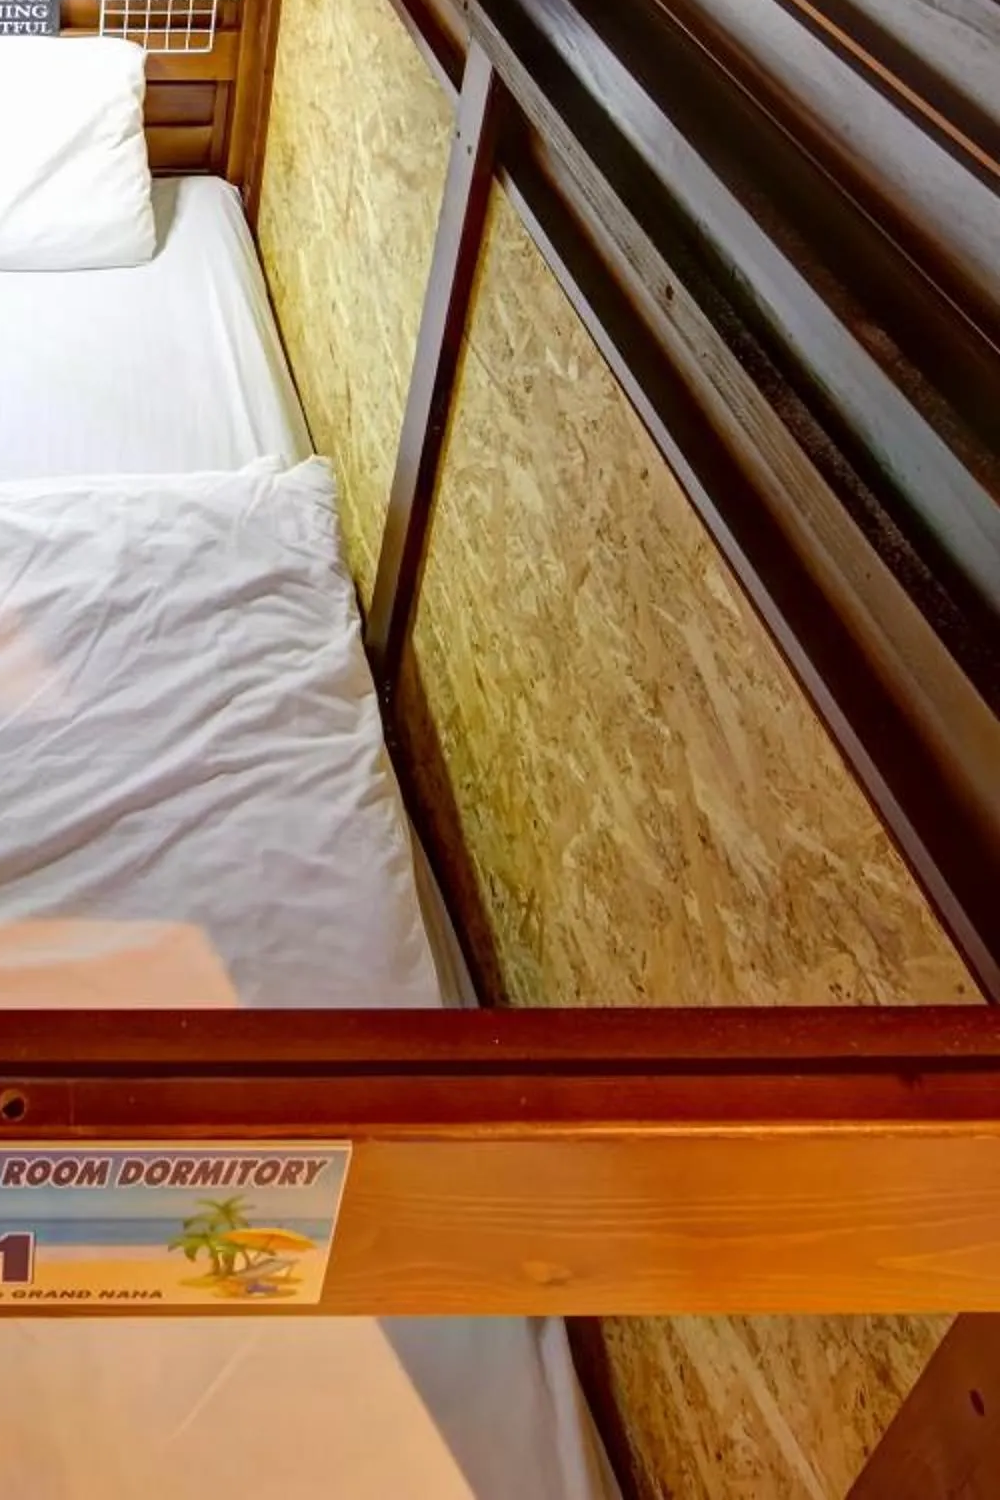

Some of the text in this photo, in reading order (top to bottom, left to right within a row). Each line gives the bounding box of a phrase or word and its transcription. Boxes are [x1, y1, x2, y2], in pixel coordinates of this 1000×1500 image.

[1, 1156, 112, 1189] ROOM
[116, 1156, 332, 1189] DORMITORY
[11, 1289, 92, 1299] GRAND
